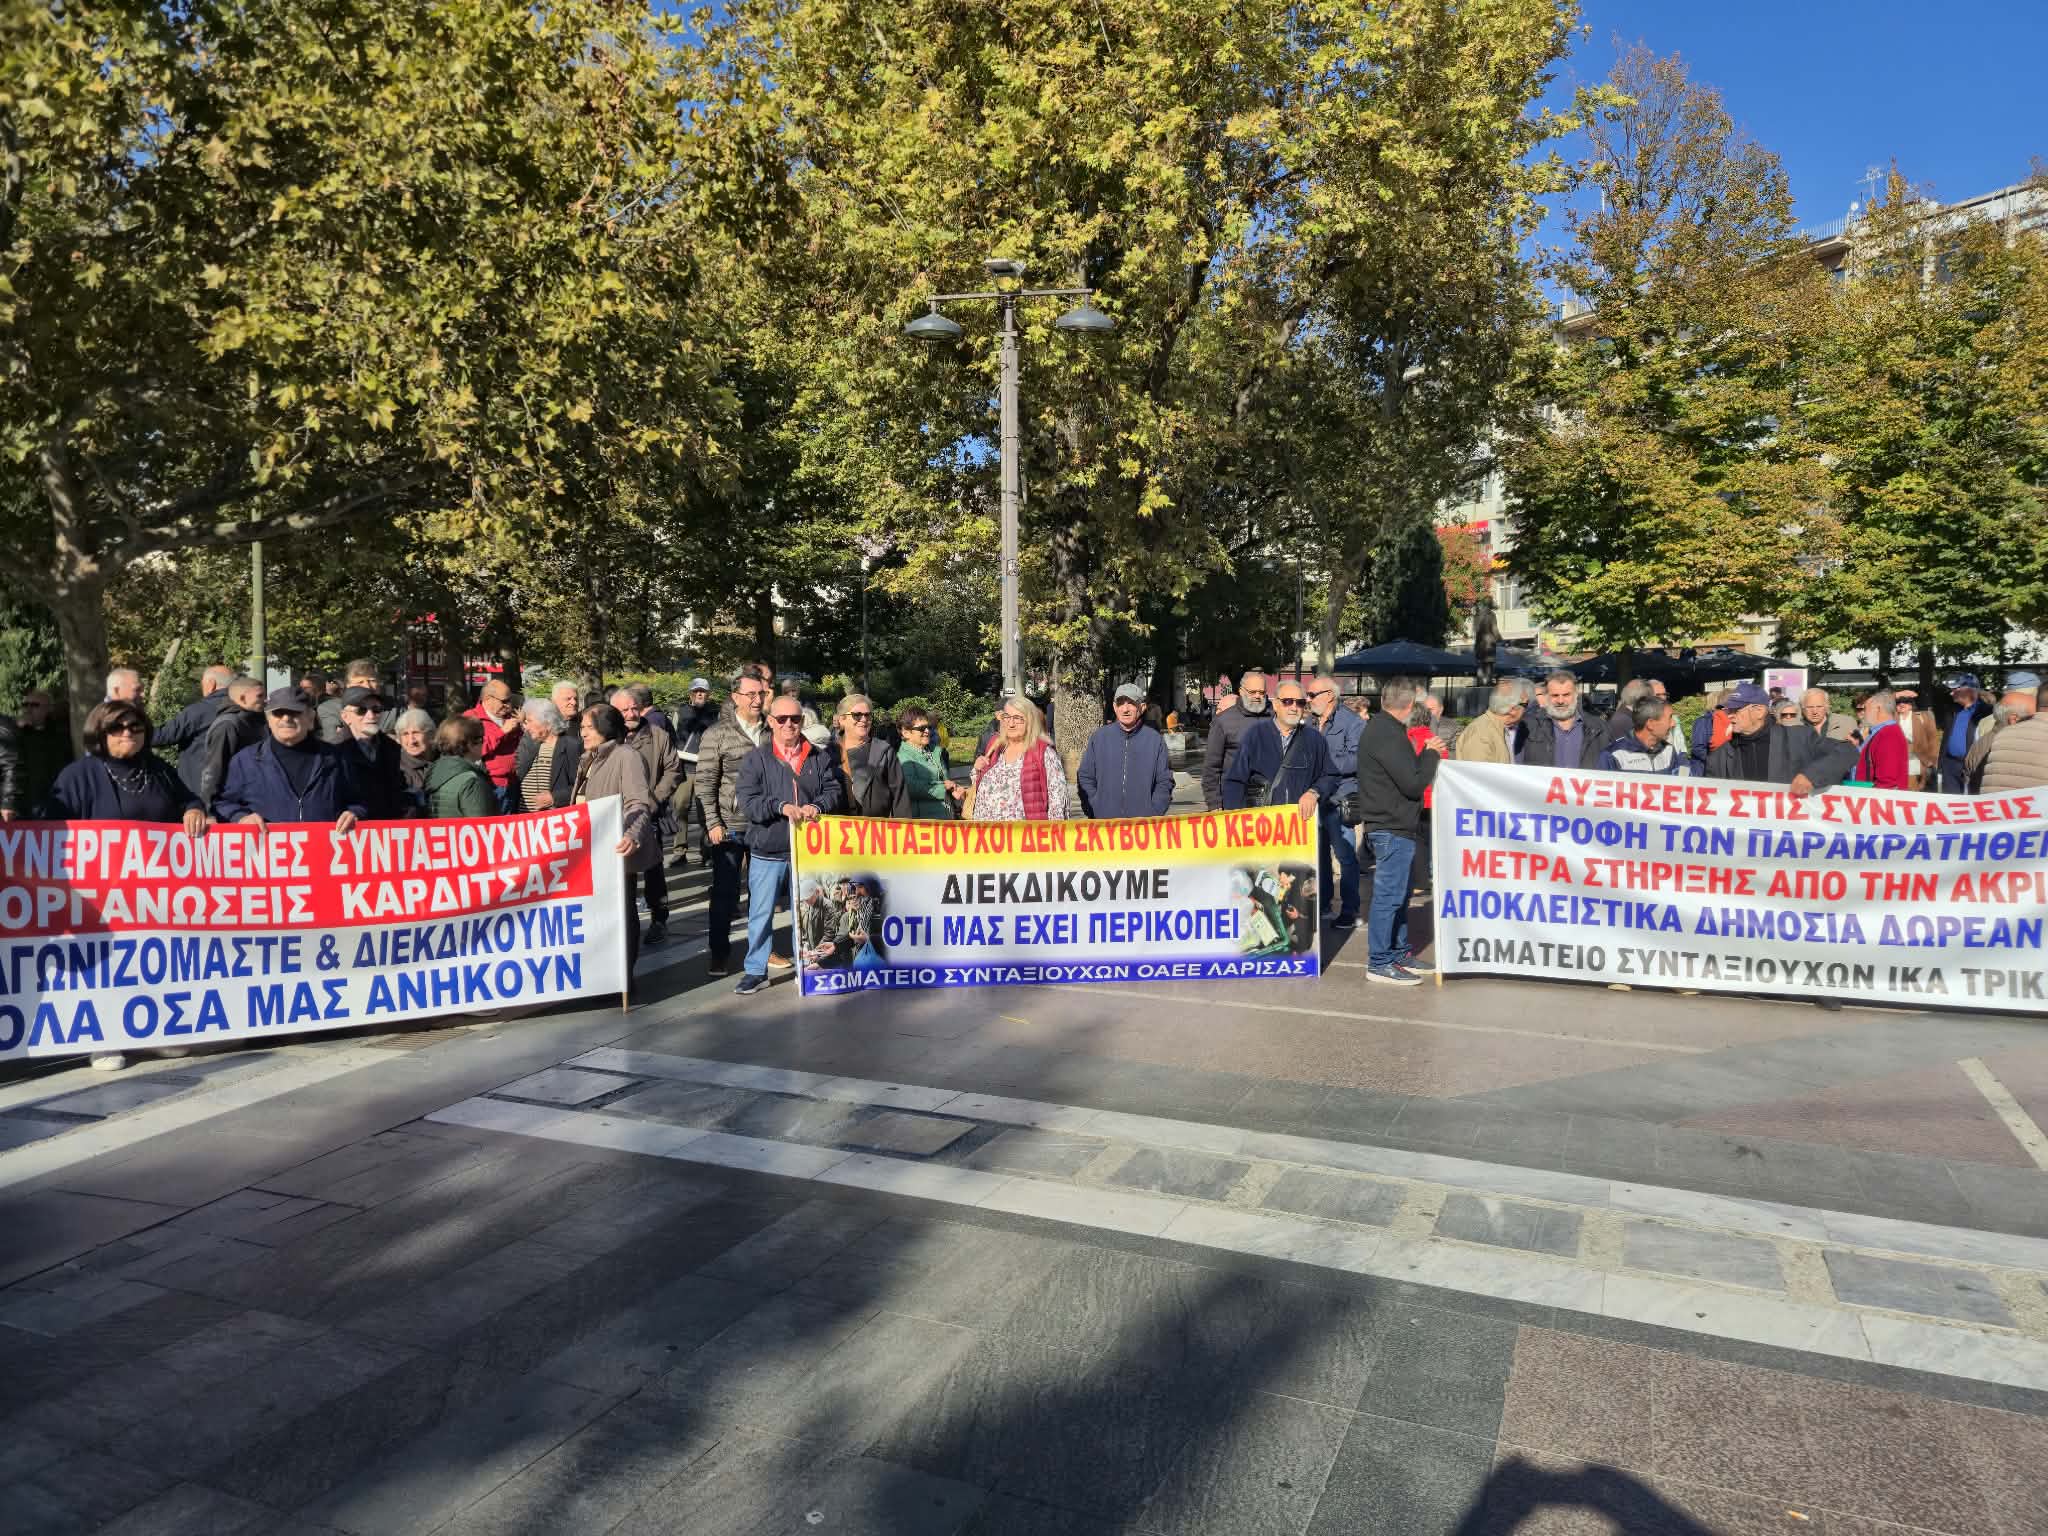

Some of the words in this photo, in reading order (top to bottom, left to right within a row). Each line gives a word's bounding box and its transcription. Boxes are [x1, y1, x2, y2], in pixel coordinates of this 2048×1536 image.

[1547, 777, 1717, 815] ΑΥΞΗΣΕΙΣ
[1729, 791, 1811, 819] ΣΤΙΣ
[1821, 796, 2041, 825] ΣΥΝΤΑΞΕΙΣ
[331, 812, 582, 874] ΣΥΝΤΑΞΙΟΥΧΙΚΕΣ
[806, 821, 831, 855] ΟΙ
[839, 820, 1013, 856] ΣΥΝΤΑΞΙΟΥΧΟΙ
[1020, 820, 1066, 852] ΔΕΝ
[1074, 819, 1183, 853] ΣΚΥΒΟΥΝ
[1187, 819, 1219, 849] ΤΟ
[1225, 812, 1308, 847] ΚΕΦΑΛΙ
[1455, 808, 1648, 849] ΕΠΙΣΤΡΟΦΗ
[1660, 825, 1734, 856] ΤΩΝ
[0, 886, 314, 929] ΟΡΓΑΝΩΣΕΙΣ
[341, 858, 569, 919] ΚΑΡΔΙΤΣΑΣ
[941, 869, 1169, 905] ΔΙΕΚΔΙΚΟΥΜΕ
[1462, 849, 1572, 883] ΜΕΤΡΑ
[1584, 858, 1756, 895] ΣΤΗΡΙΞΗΣ
[1767, 867, 1848, 901] ΑΠΟ
[1860, 872, 1938, 901] ΤΗΝ
[1950, 871, 2048, 904] ΑΚΡΙ
[315, 933, 341, 970] &
[353, 904, 584, 968] ΔΙΕΚΔΙΚΟΥΜΕ
[883, 915, 933, 946] ΟΤΙ
[942, 916, 1005, 945] ΜΑΣ
[1014, 913, 1081, 945] ΕΧΕΙ
[1087, 908, 1240, 944] ΠΕΡΙΚΟΠΕΙ
[1442, 889, 1682, 931] ΑΠΟΚΛΕΙΣΤΙΚΑ
[1695, 907, 1865, 944] ΔΗΜΟΣΙΑ
[1880, 915, 2043, 948] ΔΩΡΕΑΝ
[814, 967, 936, 990] ΣΩΜΑΤΕΙΟ
[942, 964, 1131, 985] ΣΥΝΤΑΞΙΟΥΧΩΝ
[1137, 964, 1202, 978] ΟΑΕΕ
[1206, 959, 1308, 977] ΛΑΡΙΣΑΣ
[1457, 938, 1606, 971] ΣΩΜΑΤΕΙΟ
[1617, 947, 1874, 990] ΣΥΝΤΑΞΙΟΥΧΩΝ
[1888, 965, 1949, 994] ΙΚΑ
[123, 989, 229, 1038] ΟΣΑ
[248, 977, 349, 1027] ΜΑΣ
[366, 954, 582, 1015] ΑΝΗΚΟΥΝ
